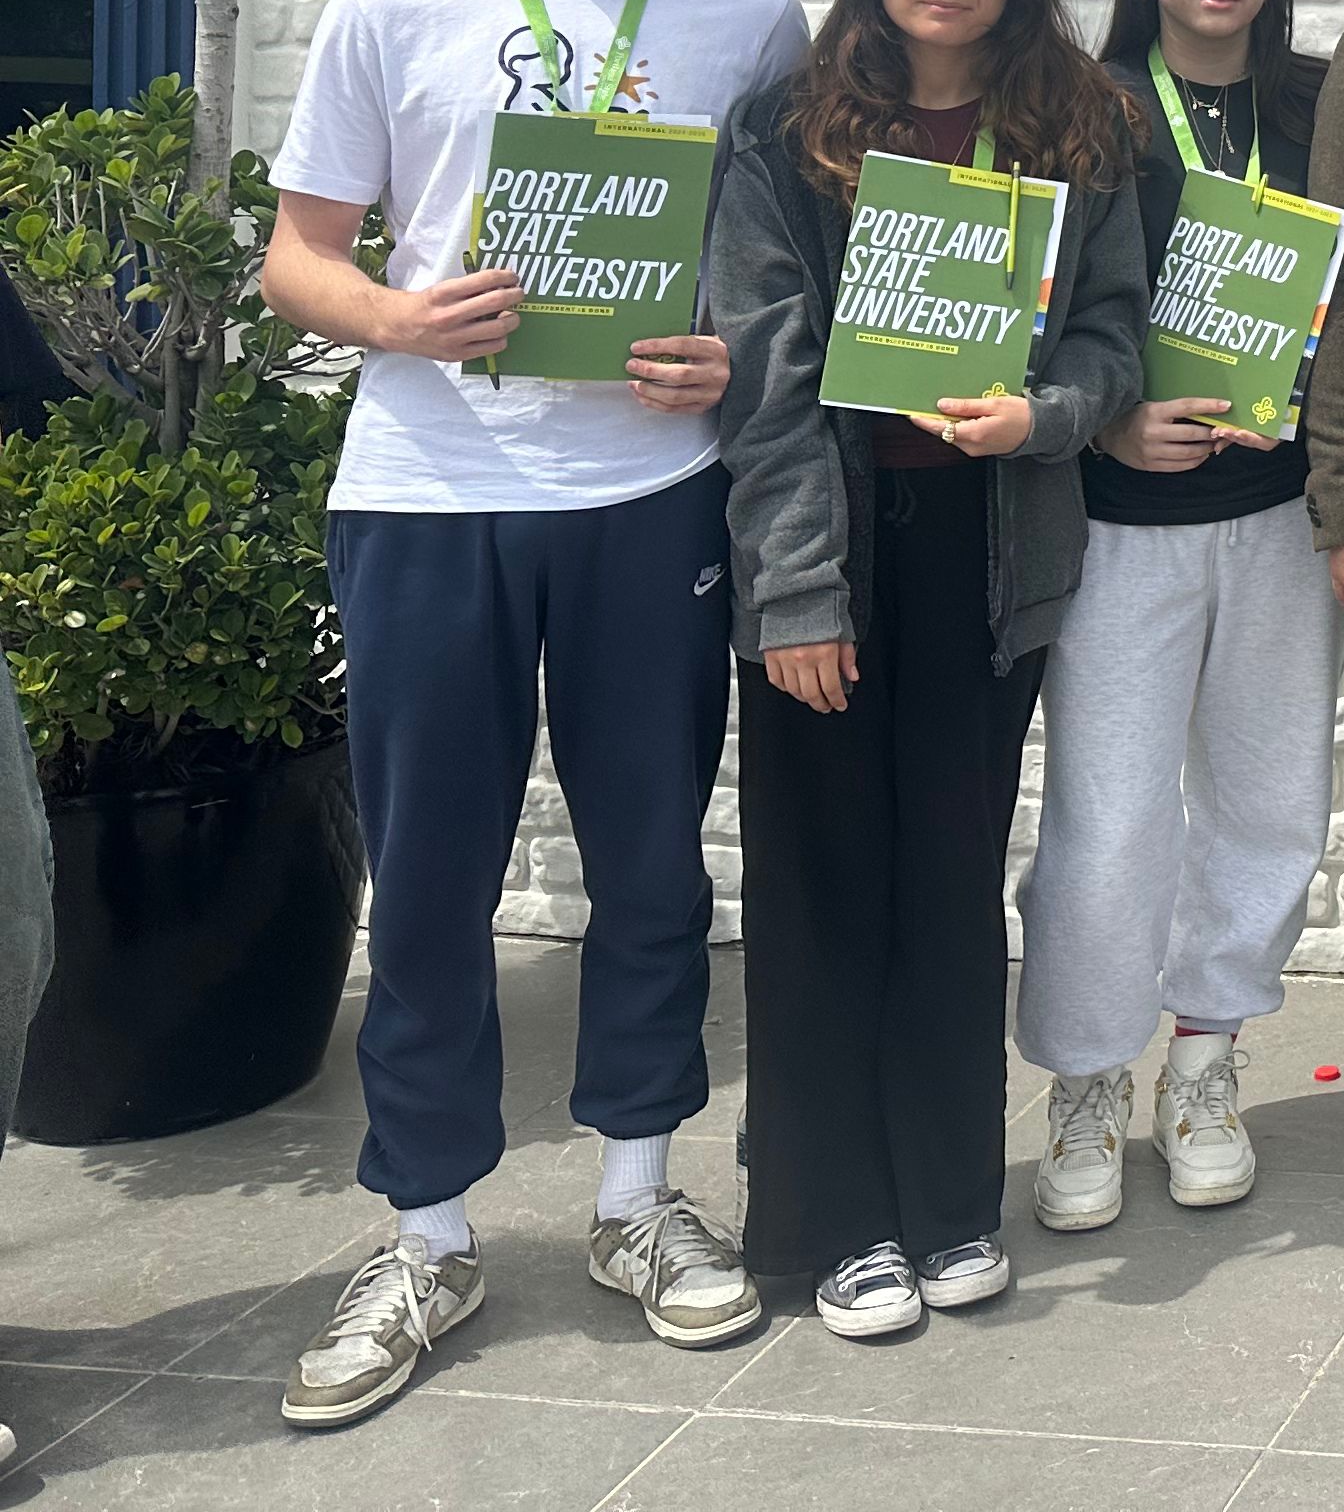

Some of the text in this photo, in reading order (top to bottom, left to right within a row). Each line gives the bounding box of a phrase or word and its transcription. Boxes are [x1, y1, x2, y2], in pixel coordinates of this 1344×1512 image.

[483, 167, 669, 218] PORTLAND
[478, 210, 584, 255] STATE
[847, 205, 1010, 265] PORTLAND
[1166, 216, 1299, 284] PORTLAND
[841, 245, 937, 293] STATE
[1156, 252, 1231, 304] STATE
[834, 284, 1022, 345] UNIVERSITY
[1149, 288, 1297, 361] UNIVERSITY
